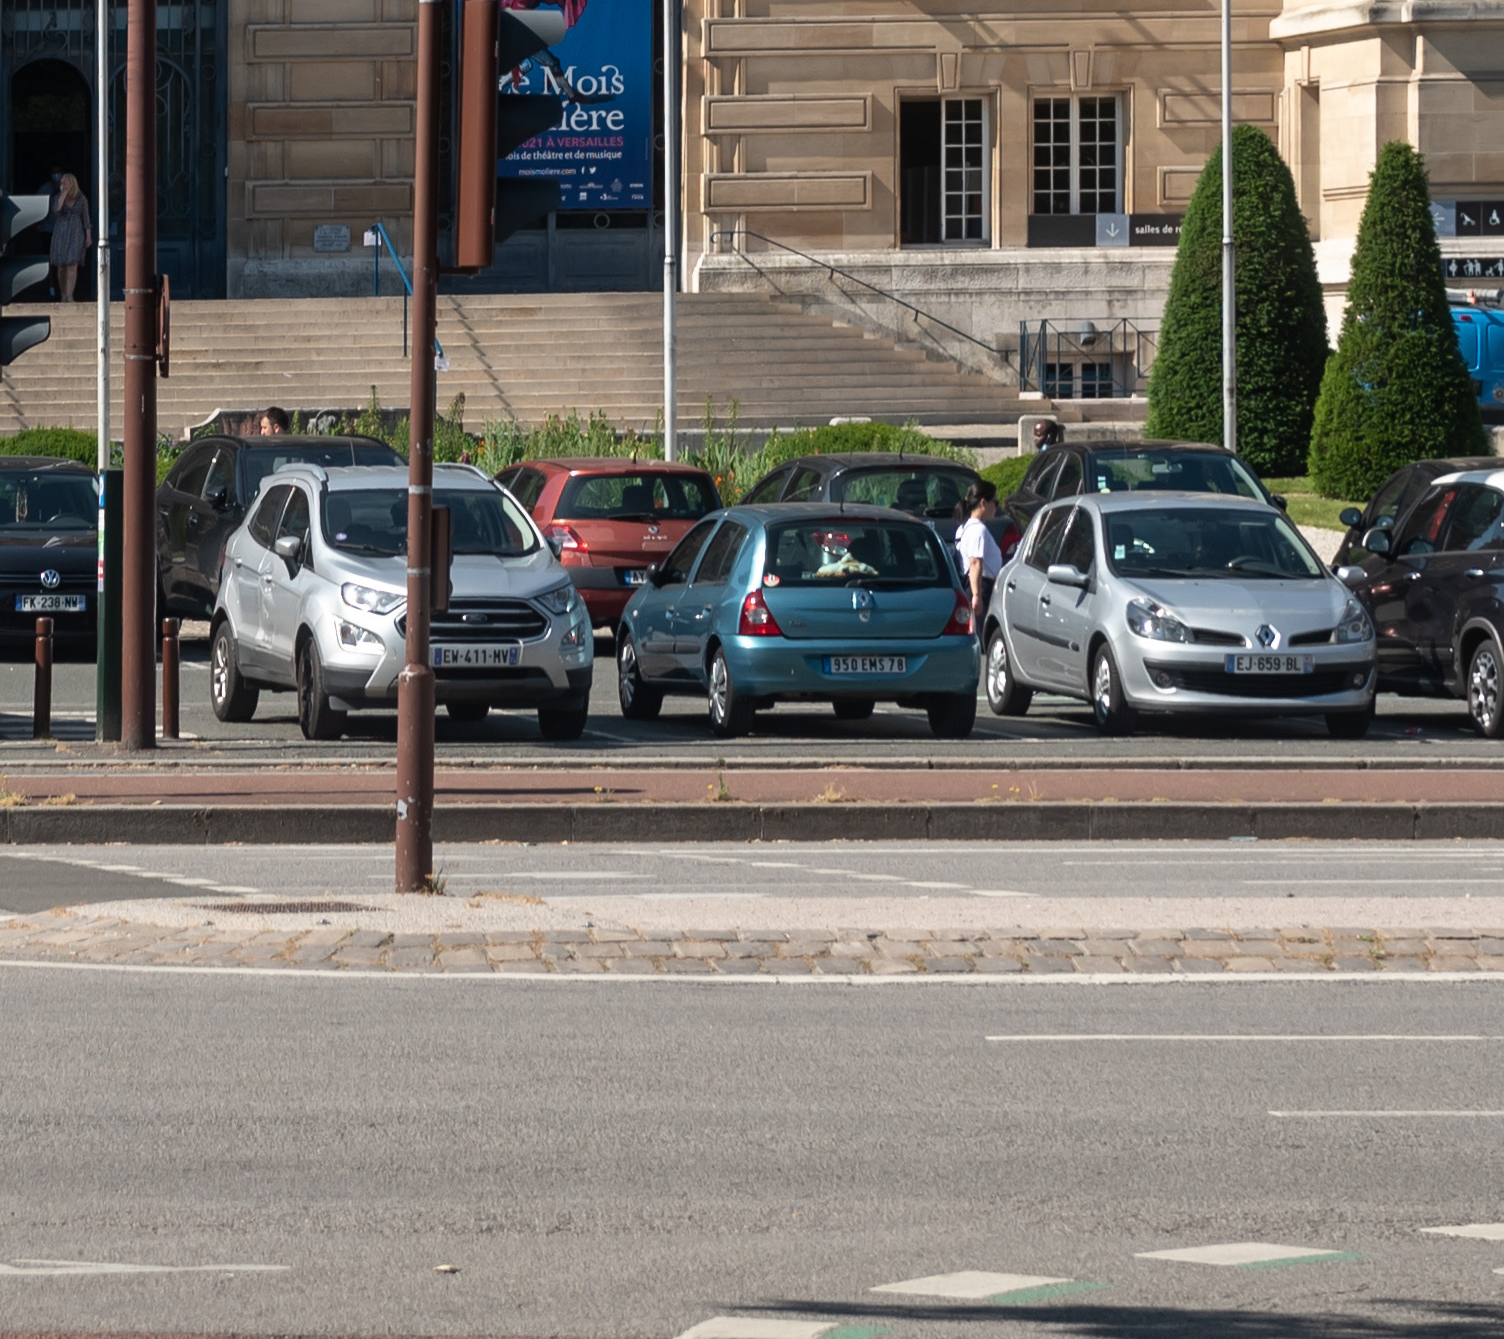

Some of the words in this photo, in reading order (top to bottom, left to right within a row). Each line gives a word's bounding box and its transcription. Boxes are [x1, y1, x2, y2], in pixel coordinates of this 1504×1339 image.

[540, 65, 625, 95] Mois
[557, 137, 624, 147] VERSAILLES
[506, 151, 520, 160] ois
[521, 152, 532, 160] de
[533, 150, 564, 160] théâtre
[574, 150, 586, 159] de
[586, 150, 623, 160] musique
[1135, 224, 1160, 234] salles
[1162, 223, 1173, 234] de
[833, 658, 858, 671] 950
[862, 658, 885, 671] EMS
[888, 657, 904, 671] 78
[1236, 656, 1301, 671] EJ-659-BL
